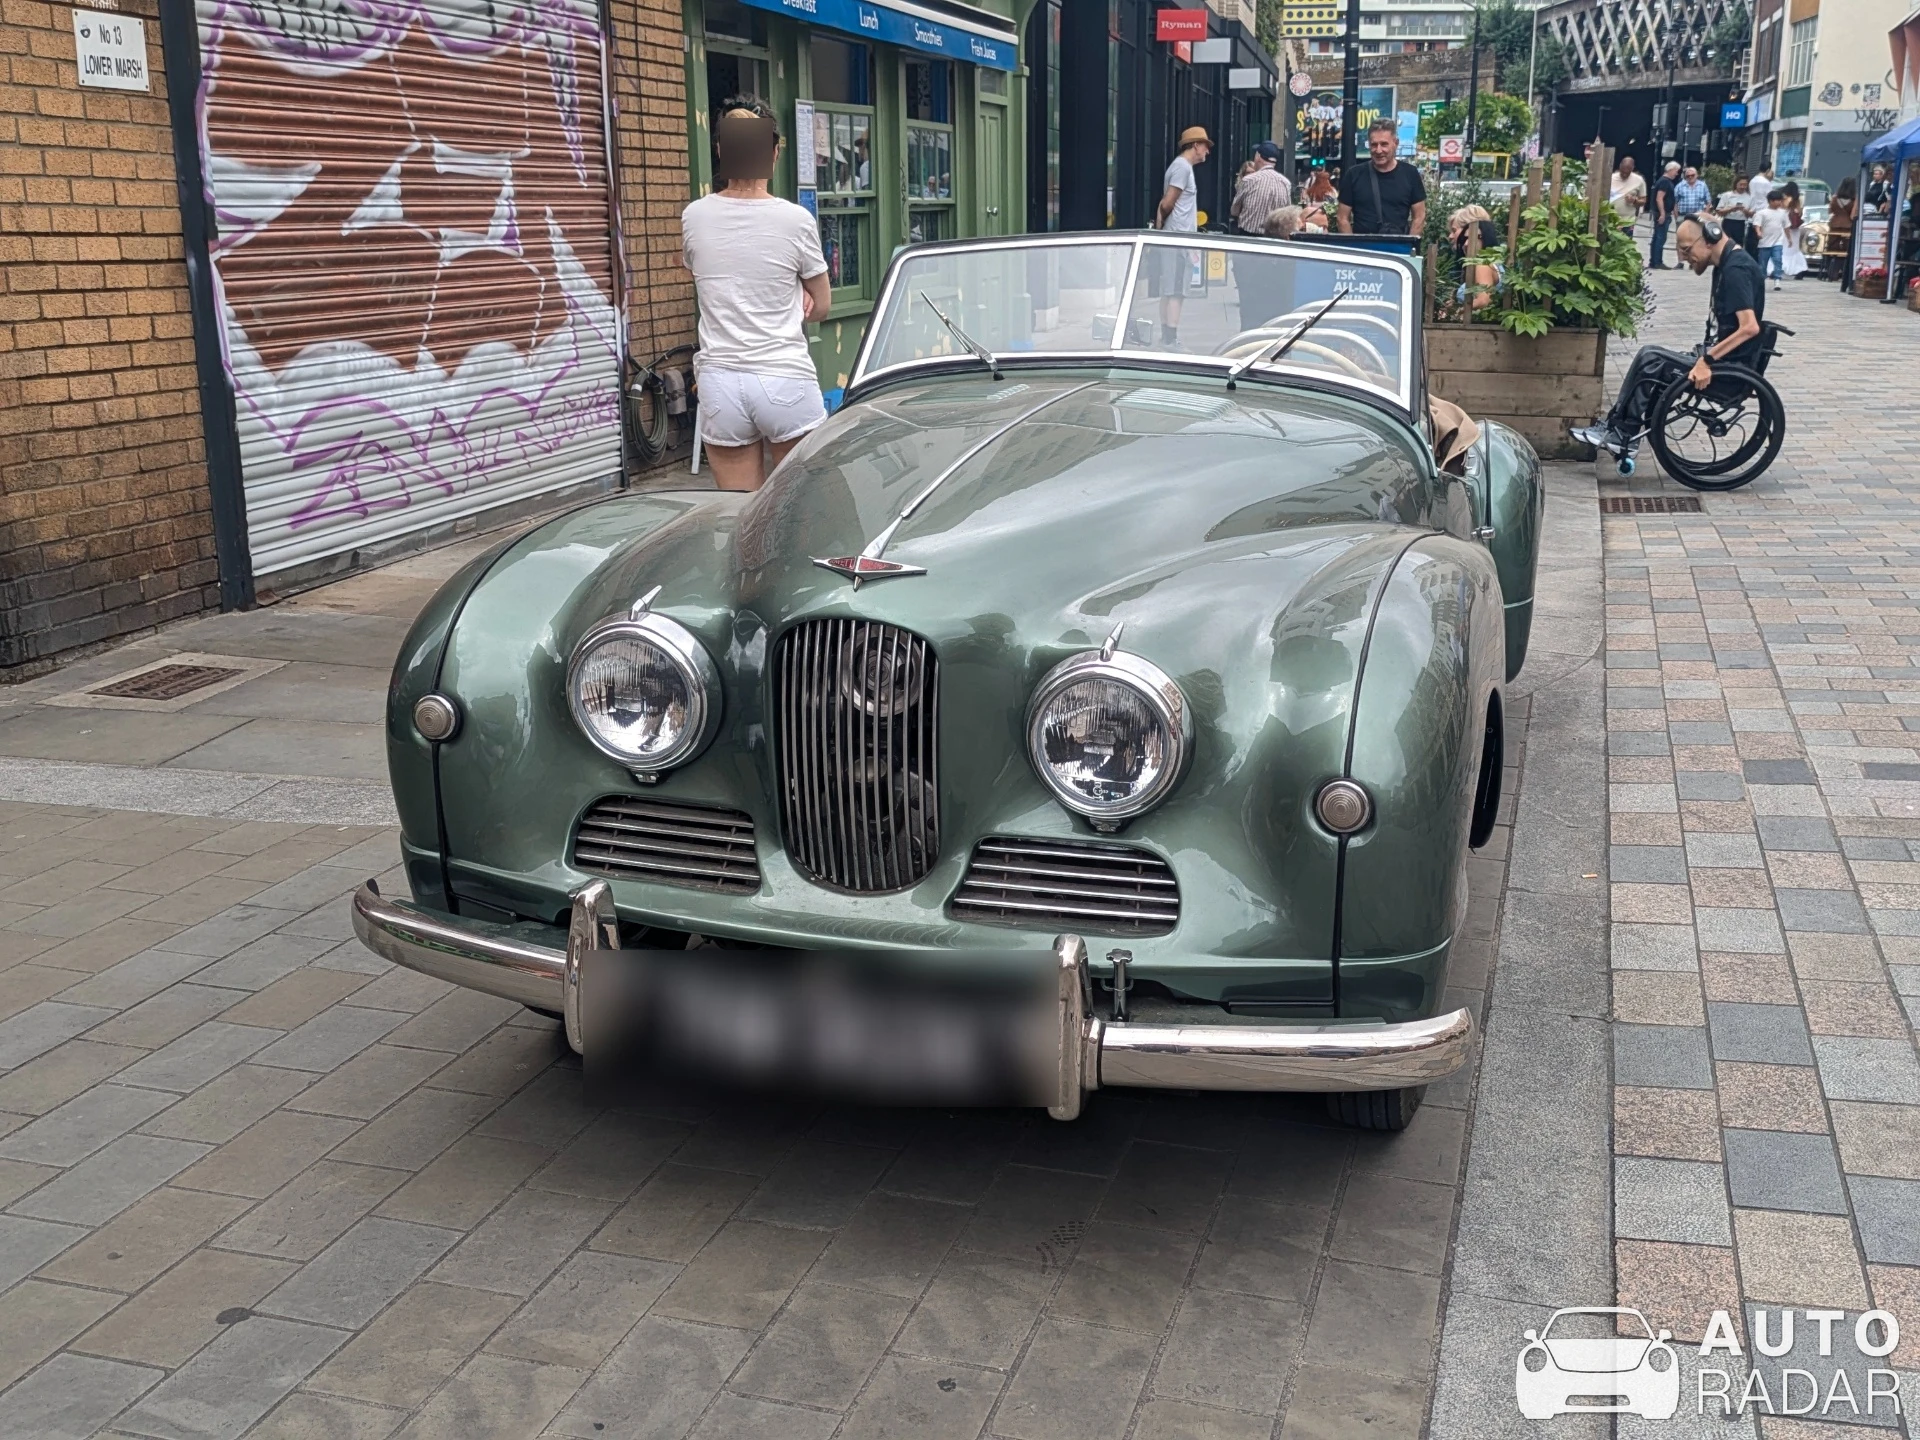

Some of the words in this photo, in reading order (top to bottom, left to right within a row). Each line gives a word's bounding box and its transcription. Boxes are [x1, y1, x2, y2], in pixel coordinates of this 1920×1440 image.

[782, 0, 817, 14] reakfast
[859, 6, 879, 30] Lunch
[914, 22, 943, 47] Smoothies
[1161, 20, 1202, 30] Ryman
[99, 24, 111, 44] No
[113, 26, 123, 46] 13
[84, 54, 113, 77] LOWER
[115, 57, 143, 79] MARSH
[1334, 269, 1357, 281] TSK
[1332, 281, 1384, 294] ALL-DAY
